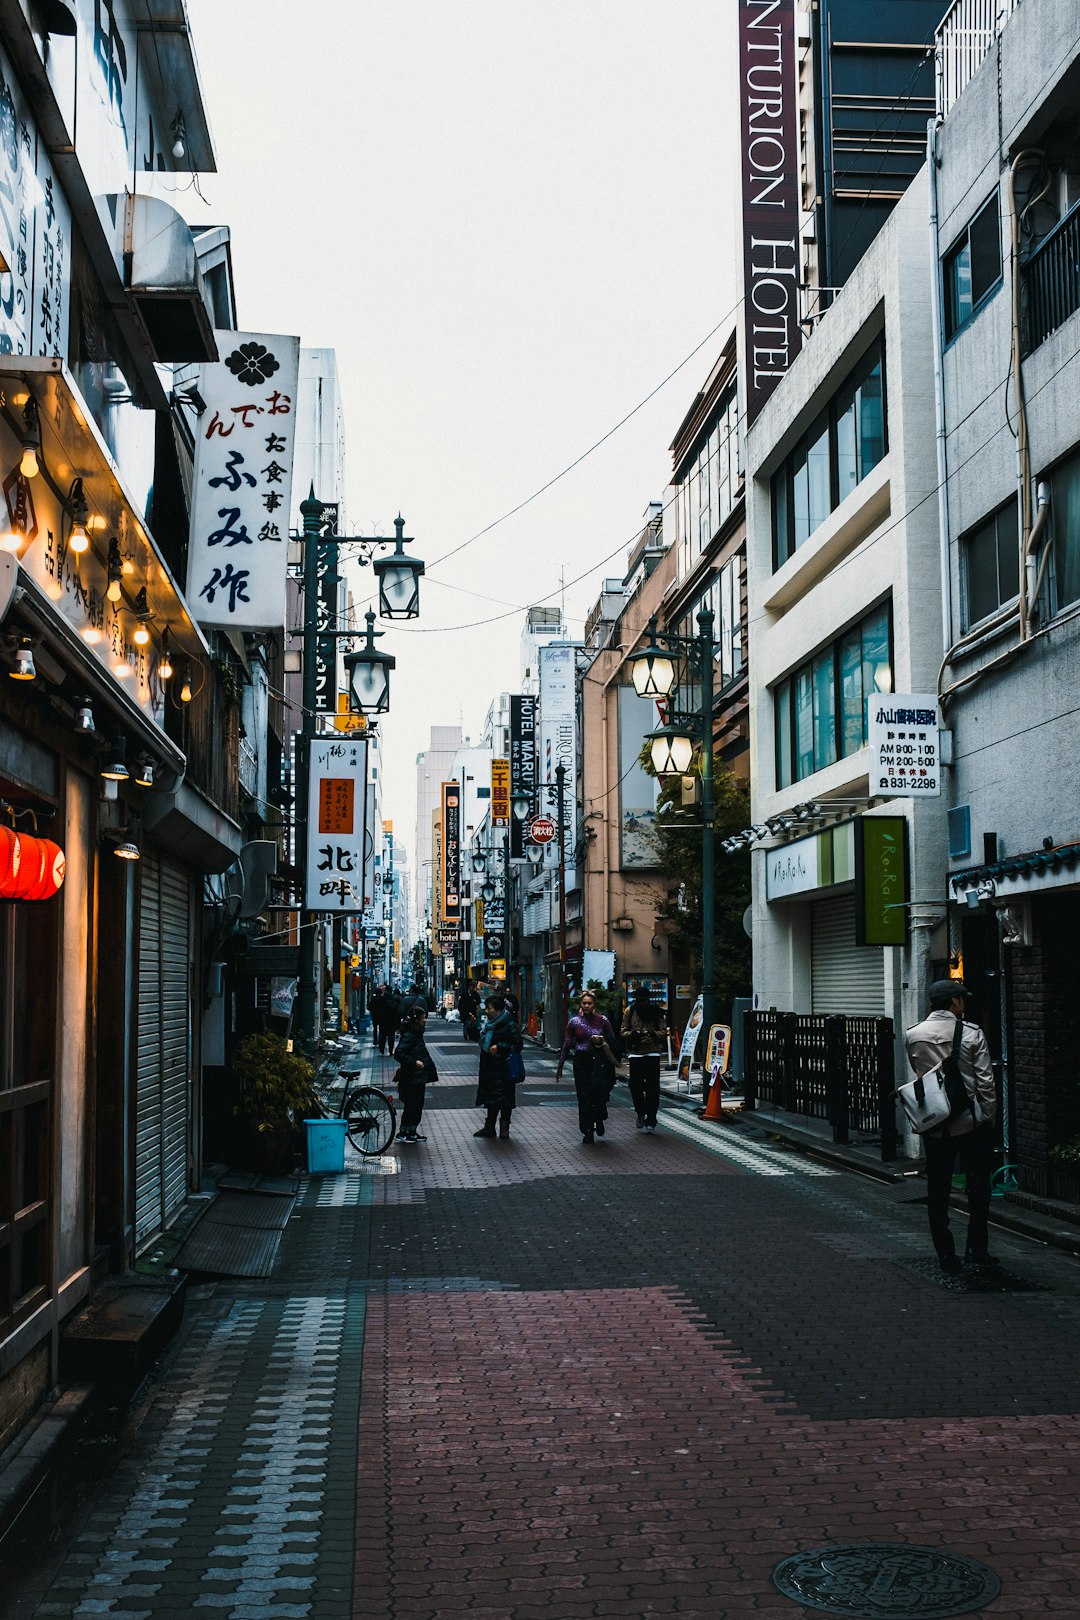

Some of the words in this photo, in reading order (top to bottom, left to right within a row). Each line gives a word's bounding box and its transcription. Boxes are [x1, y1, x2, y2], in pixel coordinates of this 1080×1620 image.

[751, 234, 796, 390] HOTEL
[206, 391, 291, 439] おでん
[258, 432, 287, 542] お食事処
[199, 450, 256, 612] ふみ作
[521, 698, 533, 735] HOTEL
[876, 707, 937, 725] 小山歯科医院
[557, 726, 573, 754] HIRO
[887, 731, 927, 740] 診療時間
[880, 744, 894, 753] AM
[880, 756, 894, 766] PM
[492, 772, 508, 816] 千里香
[496, 818, 509, 826] B1
[533, 826, 554, 836] 消火栓
[317, 844, 354, 906] 北畔
[440, 930, 459, 941] hotel
[717, 1041, 726, 1057] 駐車
